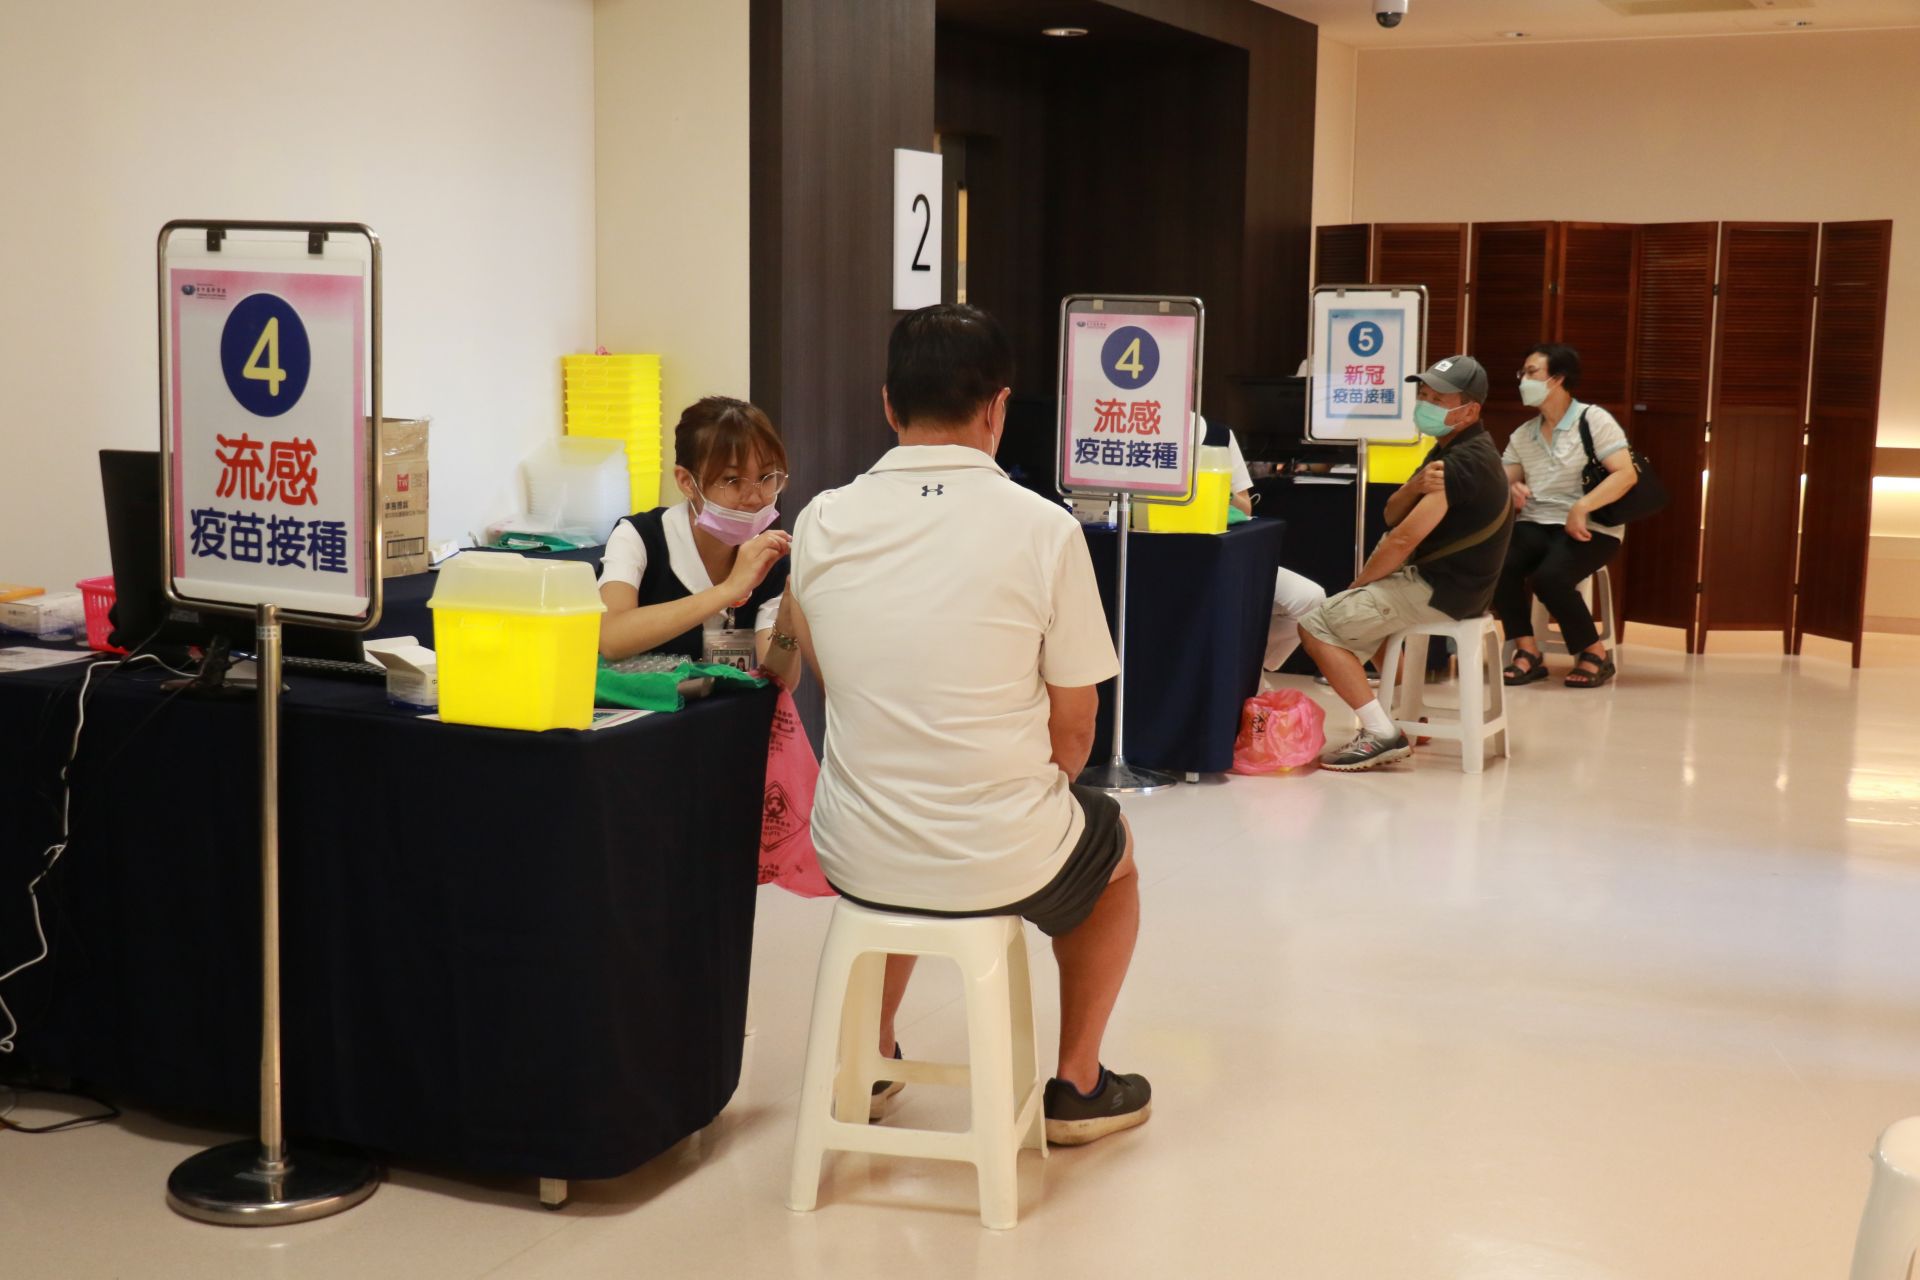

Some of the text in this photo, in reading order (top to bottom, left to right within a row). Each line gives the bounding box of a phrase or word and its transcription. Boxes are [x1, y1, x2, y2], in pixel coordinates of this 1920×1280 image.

[911, 193, 931, 271] 2
[242, 316, 287, 397] 4
[1114, 337, 1145, 380] 4
[1357, 327, 1375, 352] 5
[1344, 364, 1386, 386] 新冠
[1093, 398, 1161, 435] 流感
[1332, 388, 1395, 405] 疫苗接種
[215, 432, 319, 506] 流感
[1074, 437, 1179, 470] 疫苗接種
[190, 507, 349, 574] 疫苗接種
